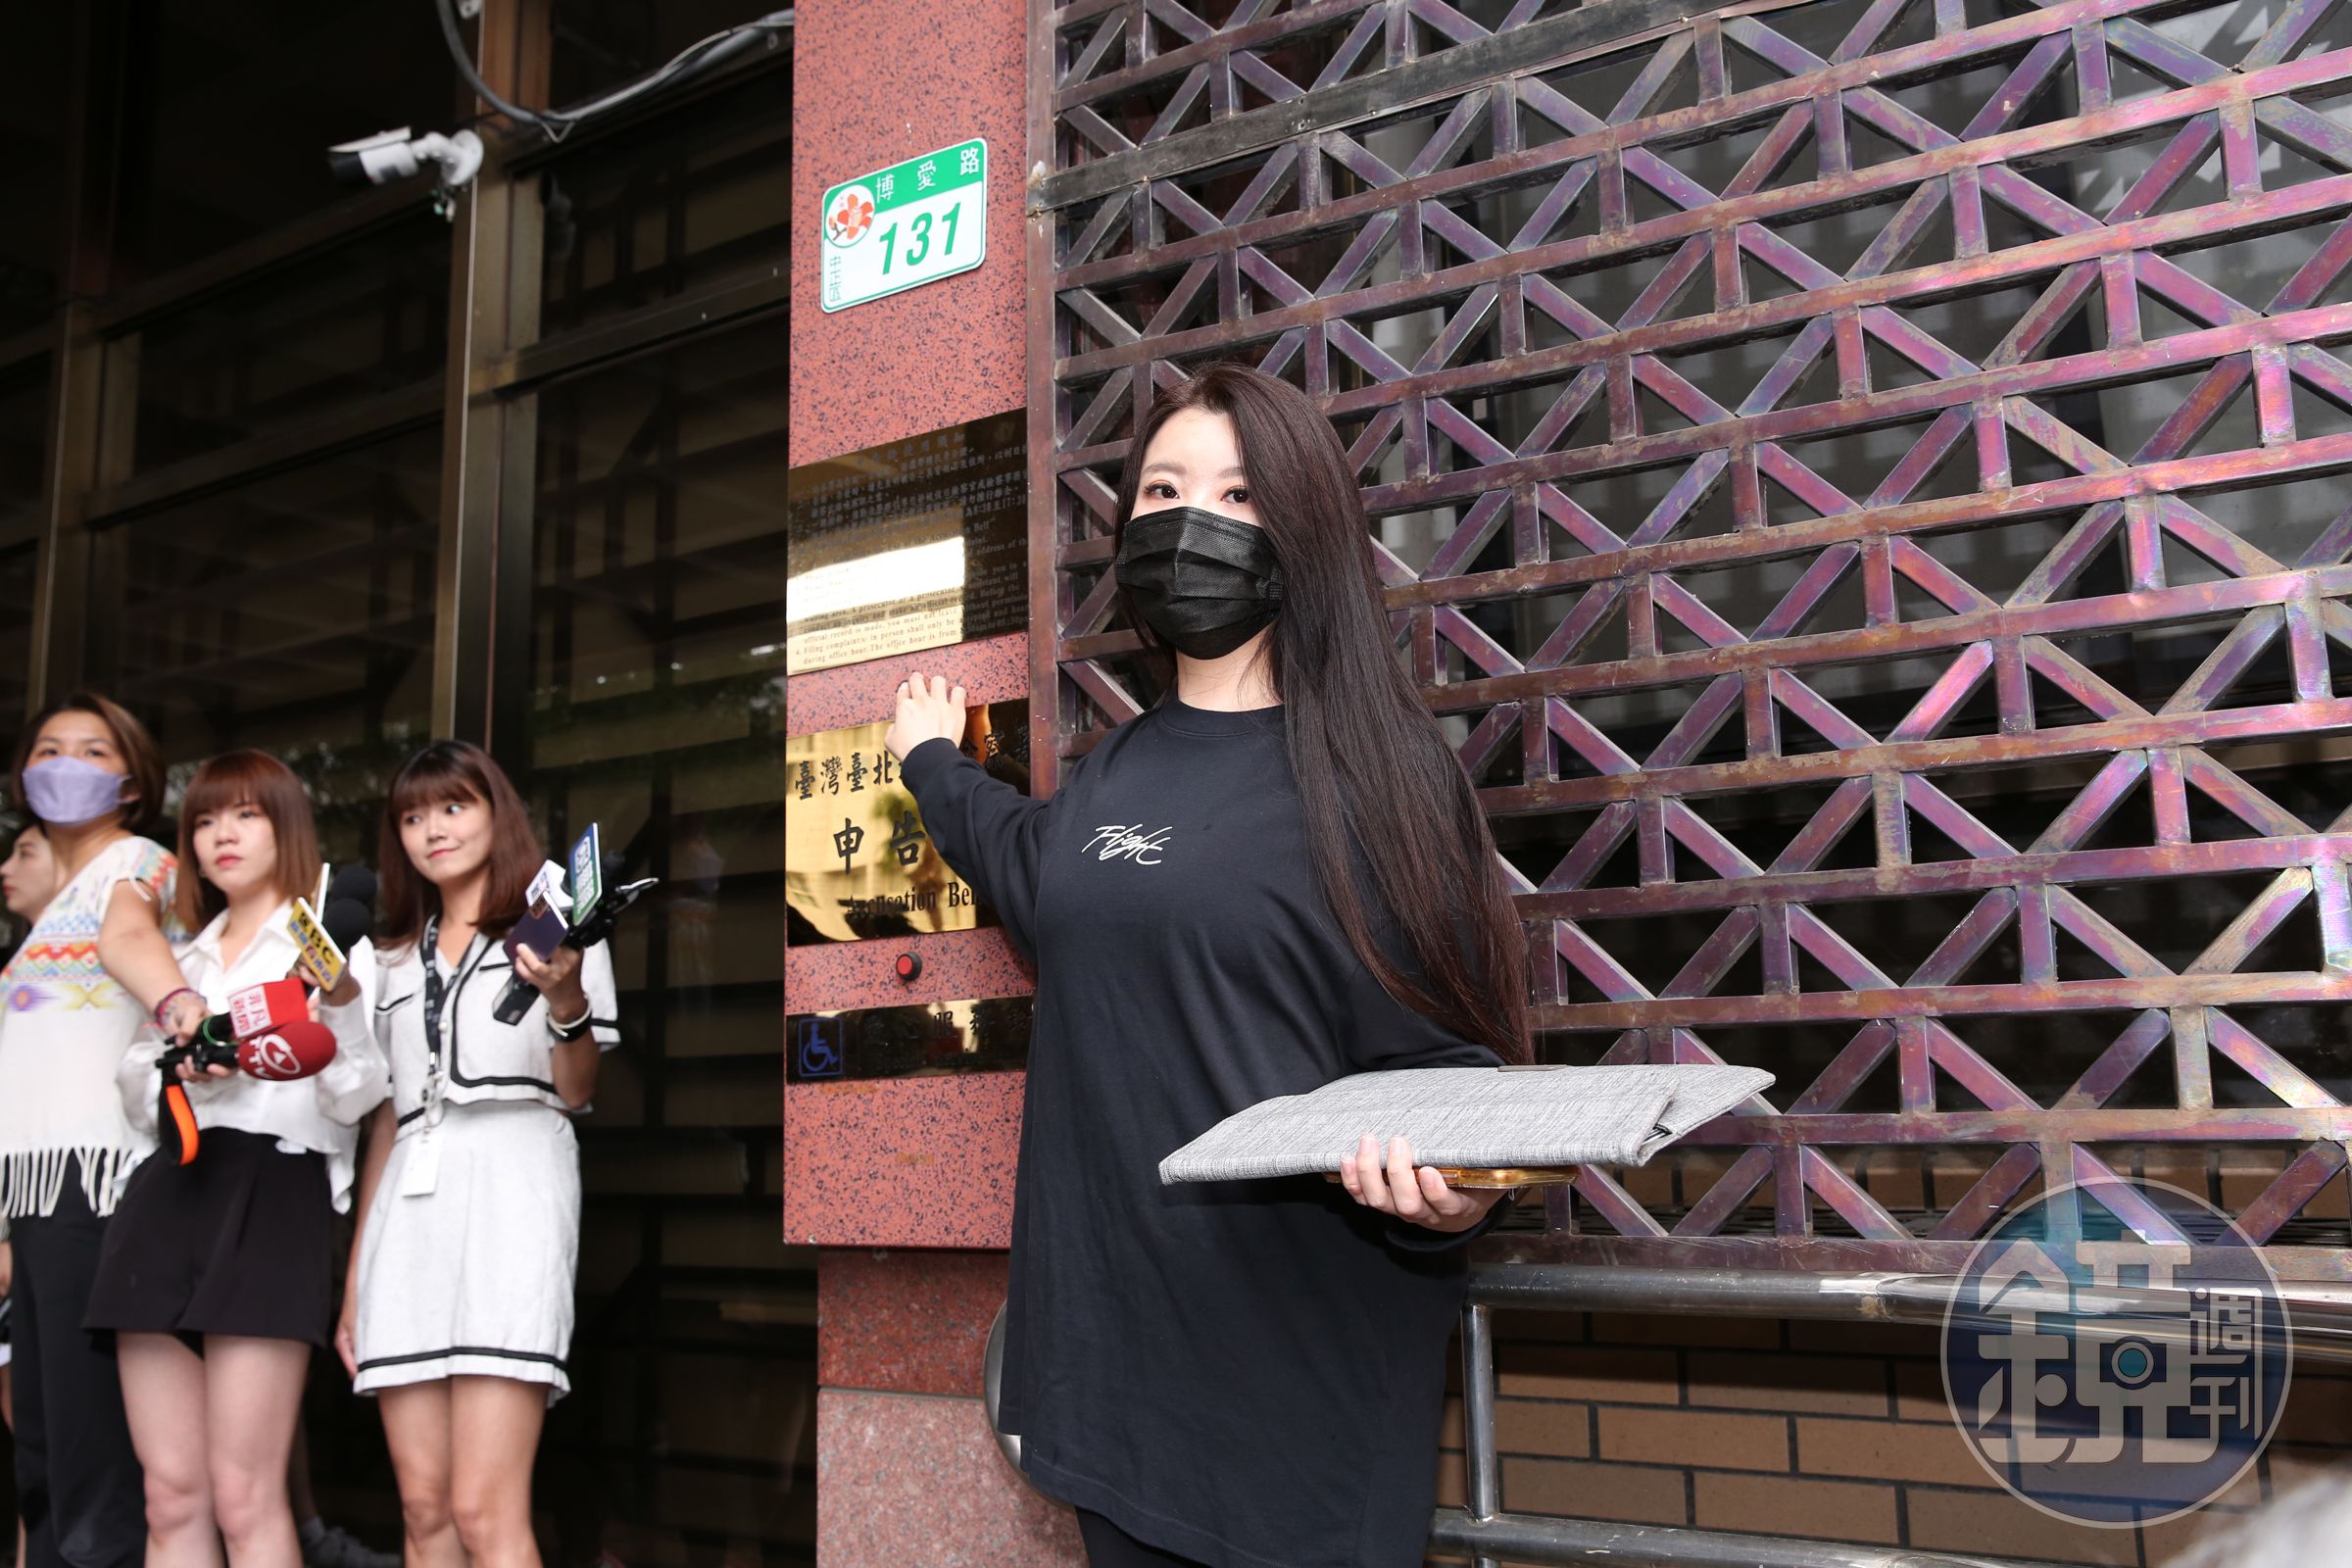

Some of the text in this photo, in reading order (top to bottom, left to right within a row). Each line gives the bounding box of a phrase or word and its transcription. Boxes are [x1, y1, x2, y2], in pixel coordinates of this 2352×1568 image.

[875, 147, 979, 203] 博愛路
[879, 202, 960, 275] 131
[828, 649, 848, 660] office
[908, 634, 926, 644] hour
[938, 628, 956, 638] from
[880, 629, 904, 641] person
[907, 624, 924, 633] shall
